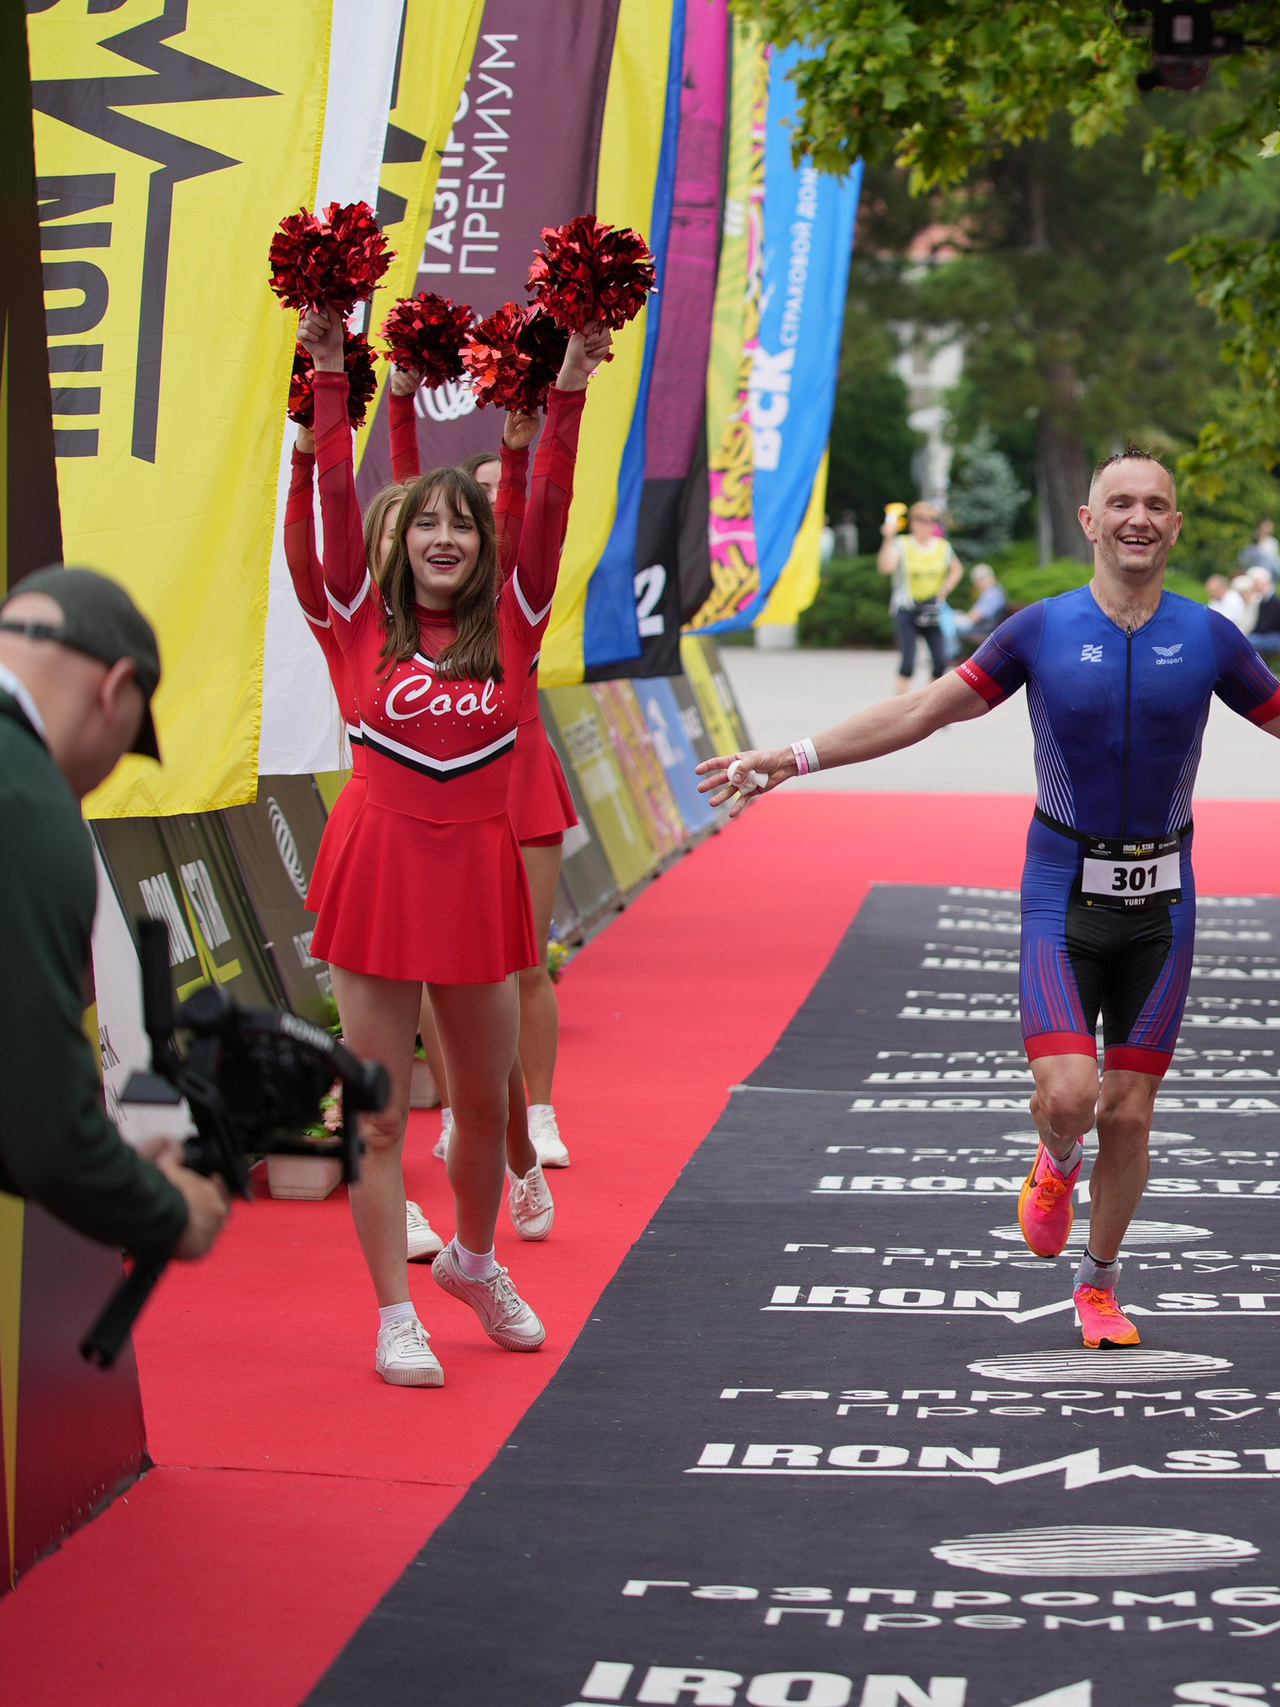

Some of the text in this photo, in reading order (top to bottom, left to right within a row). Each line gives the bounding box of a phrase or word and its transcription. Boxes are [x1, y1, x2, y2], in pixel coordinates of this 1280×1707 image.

[459, 34, 518, 274] ПРЕМИУМ
[748, 345, 796, 471] ВСК
[385, 675, 498, 720] Cool
[1112, 865, 1158, 891] 301
[180, 859, 232, 950] STAR
[1124, 898, 1146, 906] YURIY
[818, 1175, 1027, 1190] IRON
[771, 1286, 1022, 1309] IRON
[696, 1443, 1001, 1469] IRON
[580, 1661, 967, 1707] IRON
